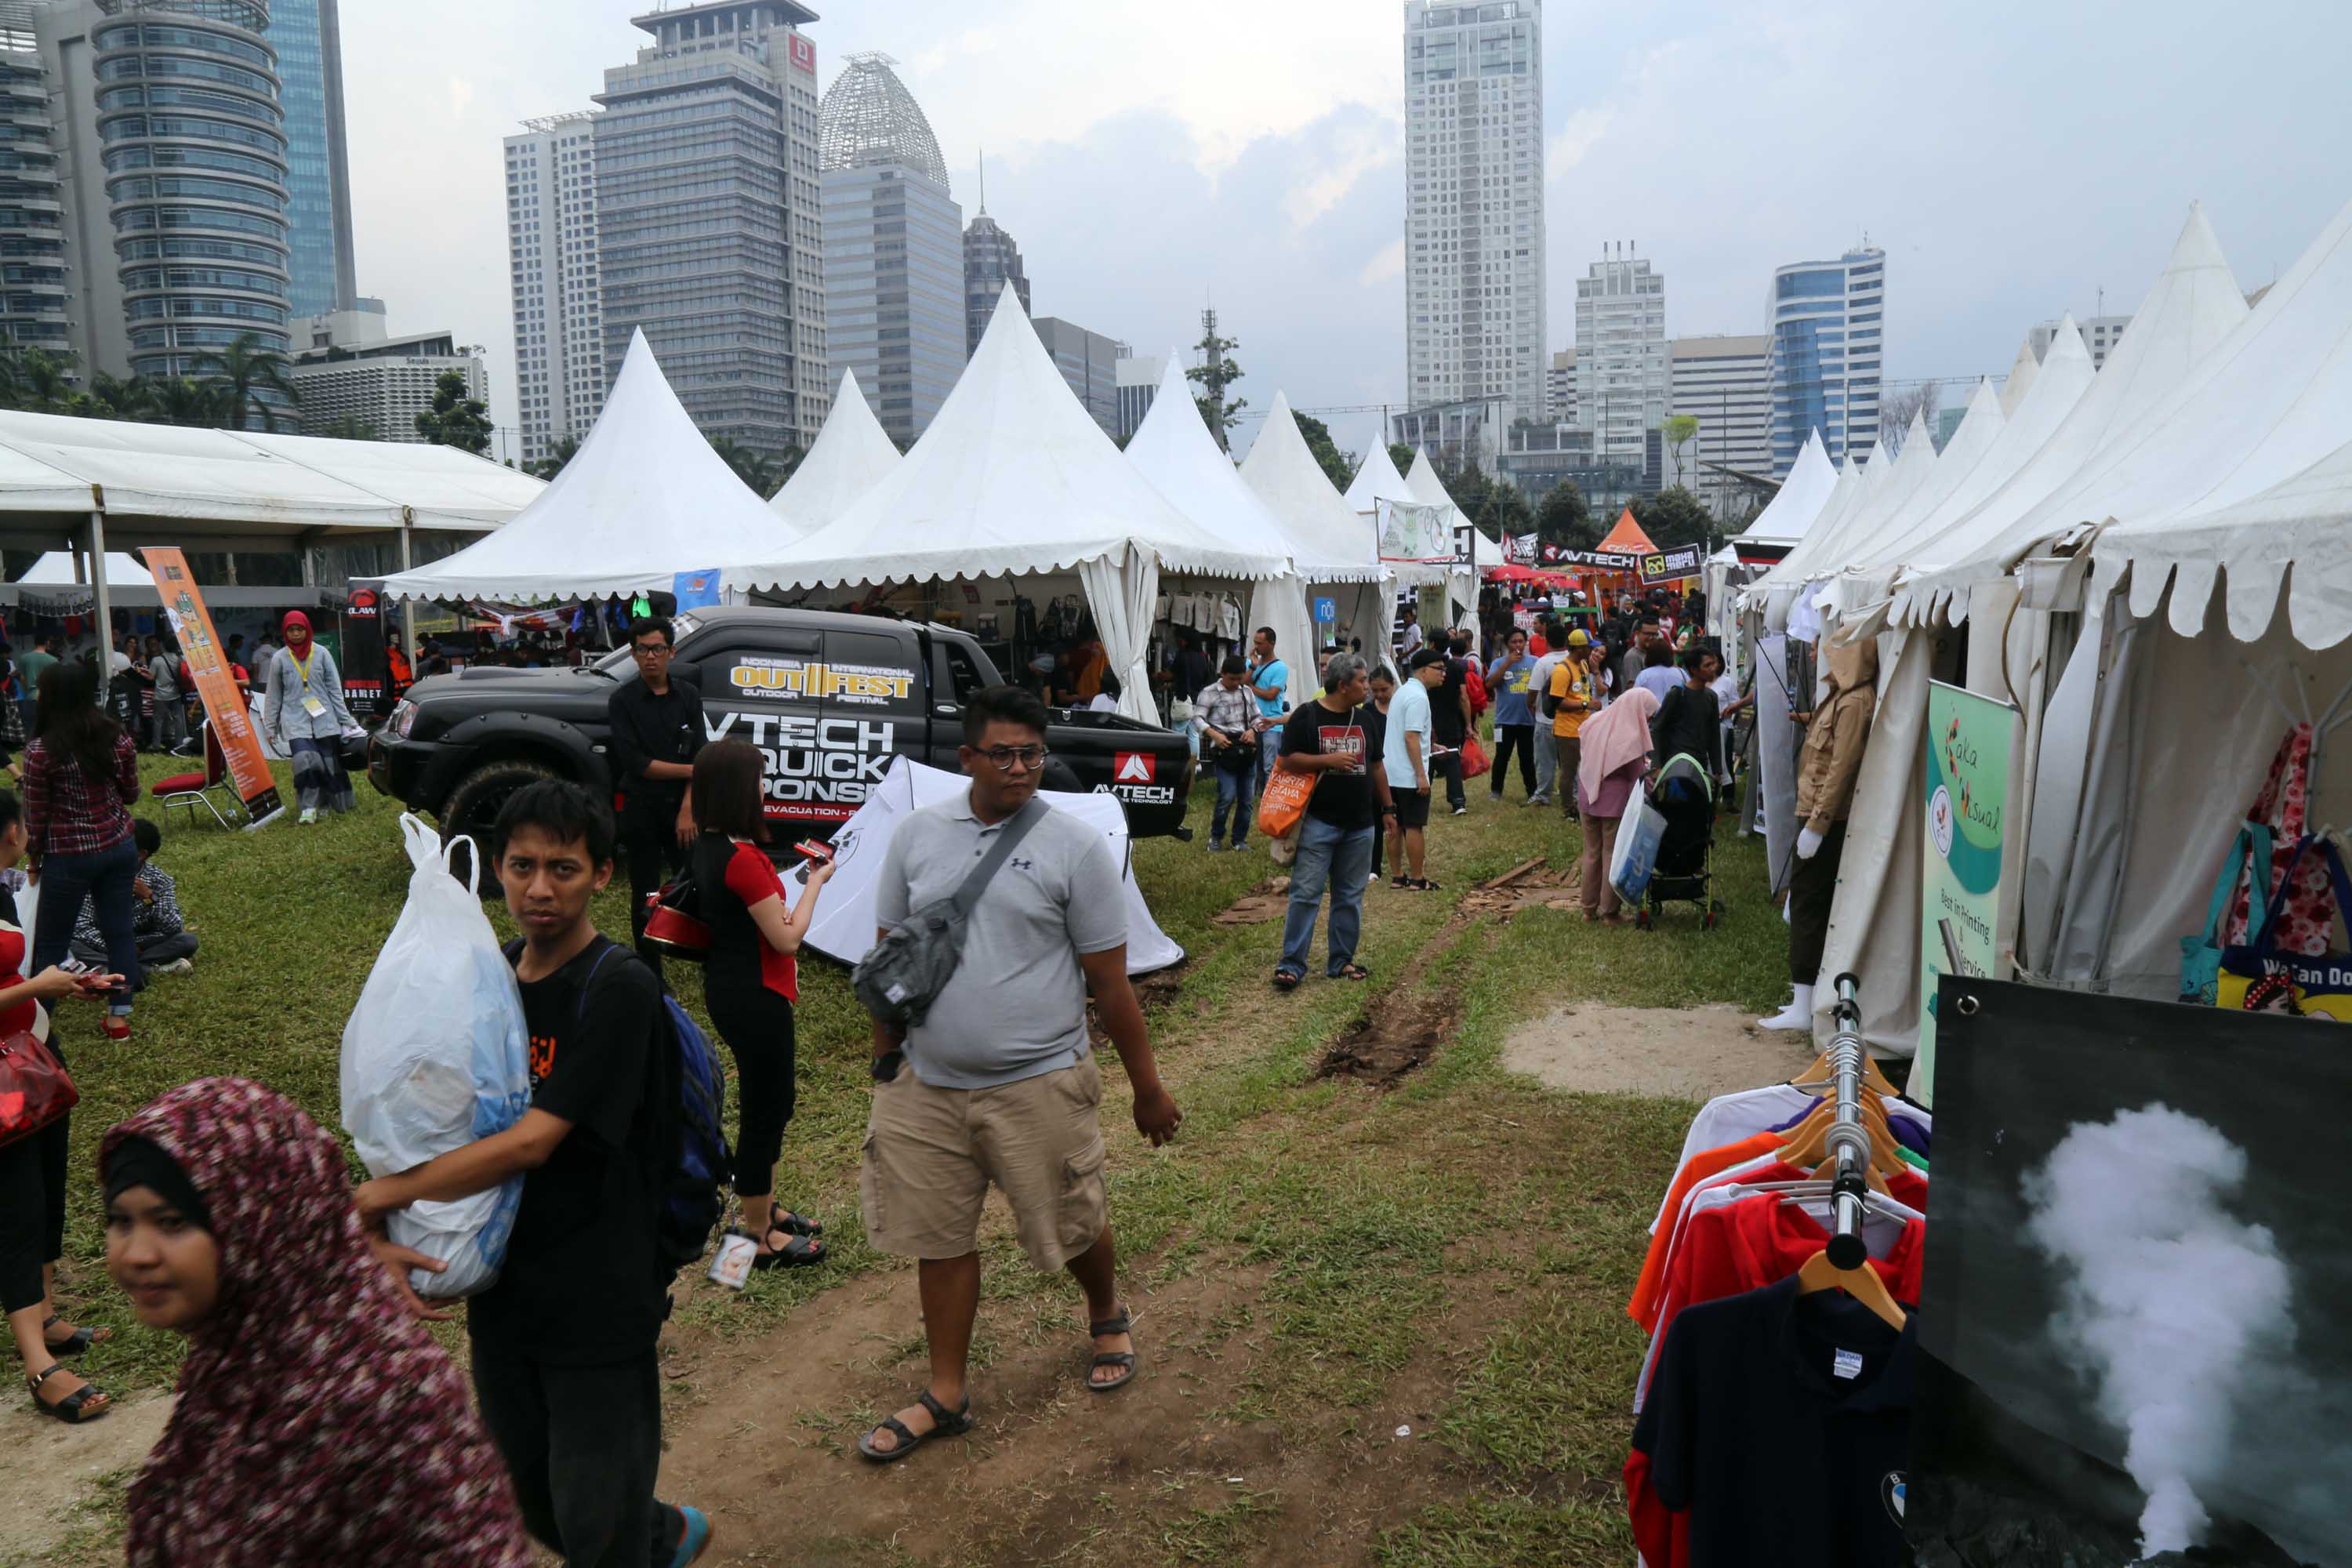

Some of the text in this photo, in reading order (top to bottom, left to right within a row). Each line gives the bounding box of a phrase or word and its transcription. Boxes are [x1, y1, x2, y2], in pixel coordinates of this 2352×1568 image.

[1558, 550, 1635, 568] AVTECH
[740, 656, 915, 677] INDONESIA INTERNATIONAL
[742, 689, 889, 706] OUTDOOR FESTIVAL
[703, 711, 894, 753] VTECH
[764, 805, 840, 816] EVACUATION
[1940, 887, 1990, 946] Best in Printing
